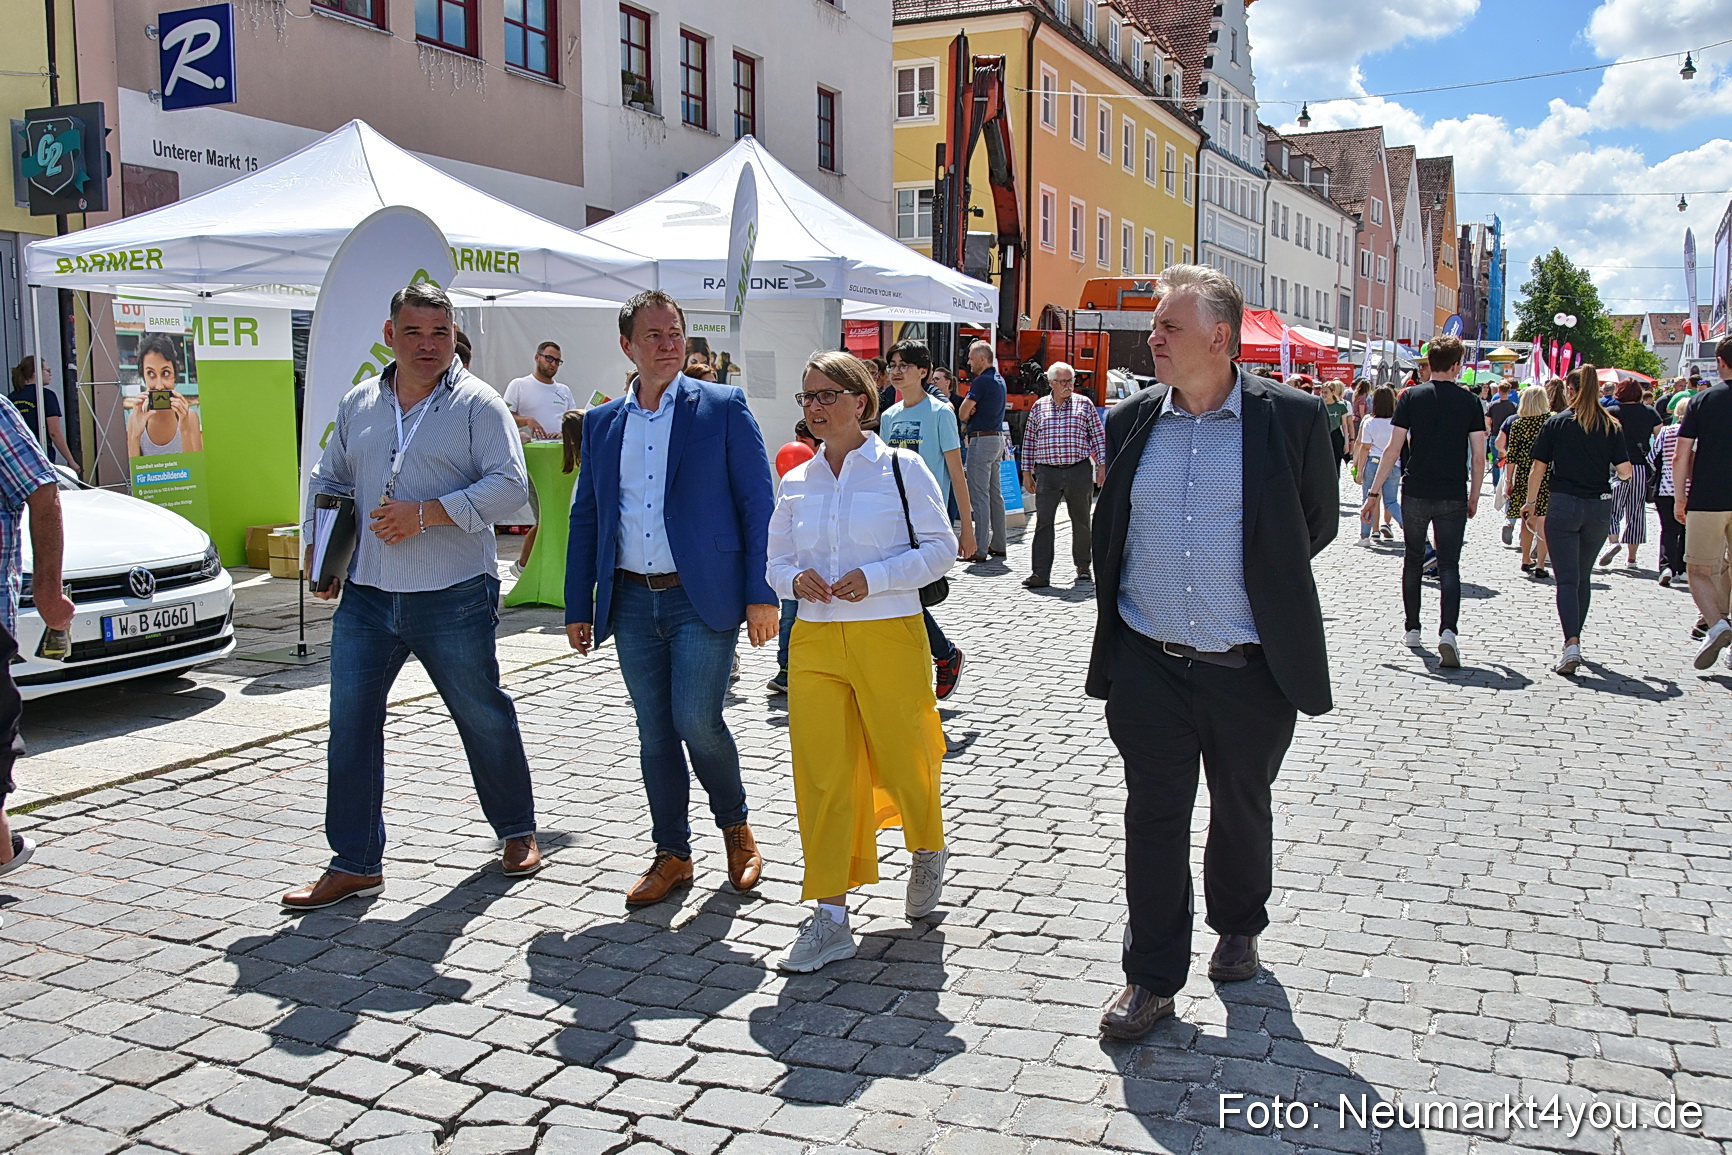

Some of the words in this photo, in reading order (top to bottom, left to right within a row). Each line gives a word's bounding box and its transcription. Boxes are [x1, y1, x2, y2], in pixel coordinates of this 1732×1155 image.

[152, 139, 203, 163] Unterer
[206, 150, 241, 171] Markt
[245, 157, 259, 172] 15
[55, 247, 164, 274] BARMER
[450, 247, 520, 274] RMER
[703, 277, 789, 289] RAONE
[848, 284, 878, 296] SOLUTIONS
[878, 289, 892, 298] YOUR
[149, 317, 180, 327] BARMER
[192, 316, 259, 346] MER
[692, 323, 727, 333] BARMER
[136, 474, 147, 483] Für
[147, 470, 187, 481] Auszubildende
[153, 607, 188, 630] 4060
